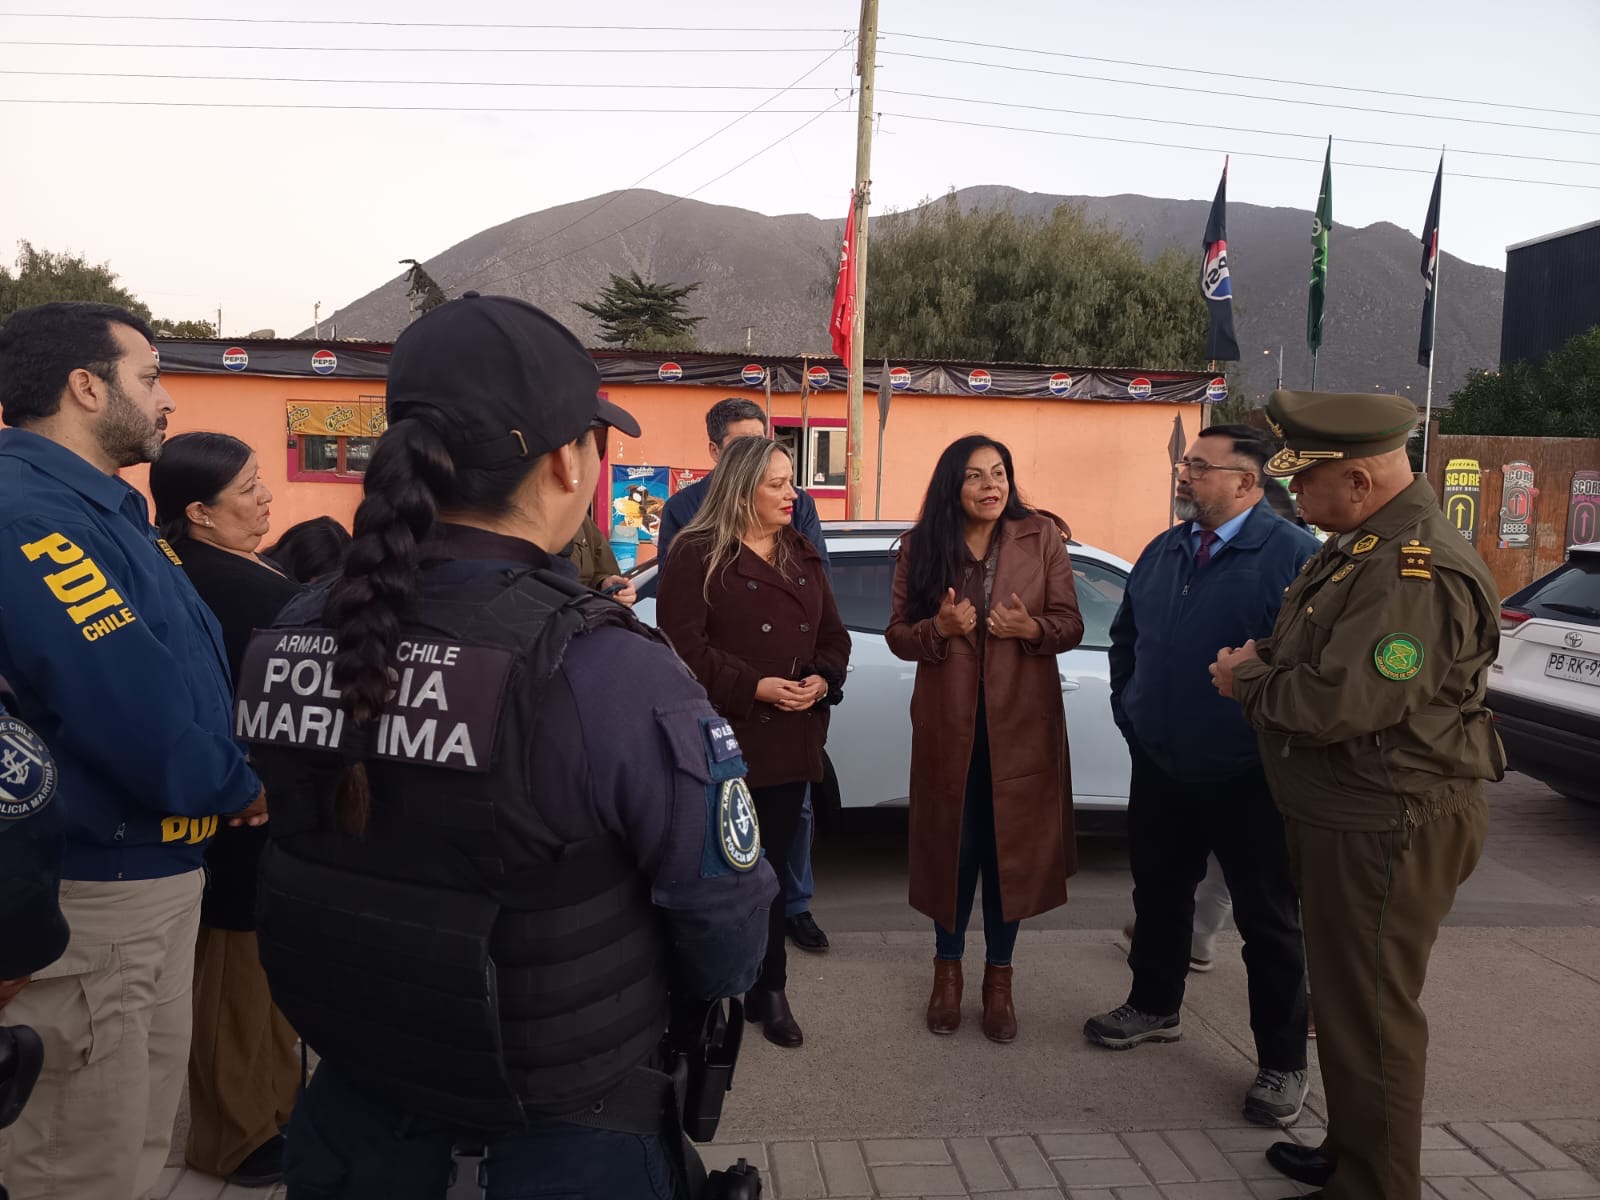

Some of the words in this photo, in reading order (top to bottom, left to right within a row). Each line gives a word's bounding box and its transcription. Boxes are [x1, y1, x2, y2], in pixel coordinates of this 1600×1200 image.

[1446, 472, 1480, 487] SCORE
[20, 532, 124, 625] PDI
[82, 607, 137, 642] CHILE
[396, 641, 460, 666] CHILE
[263, 657, 448, 711] POLIA
[9, 722, 34, 741] CHILE
[236, 699, 477, 767] MARIIMA
